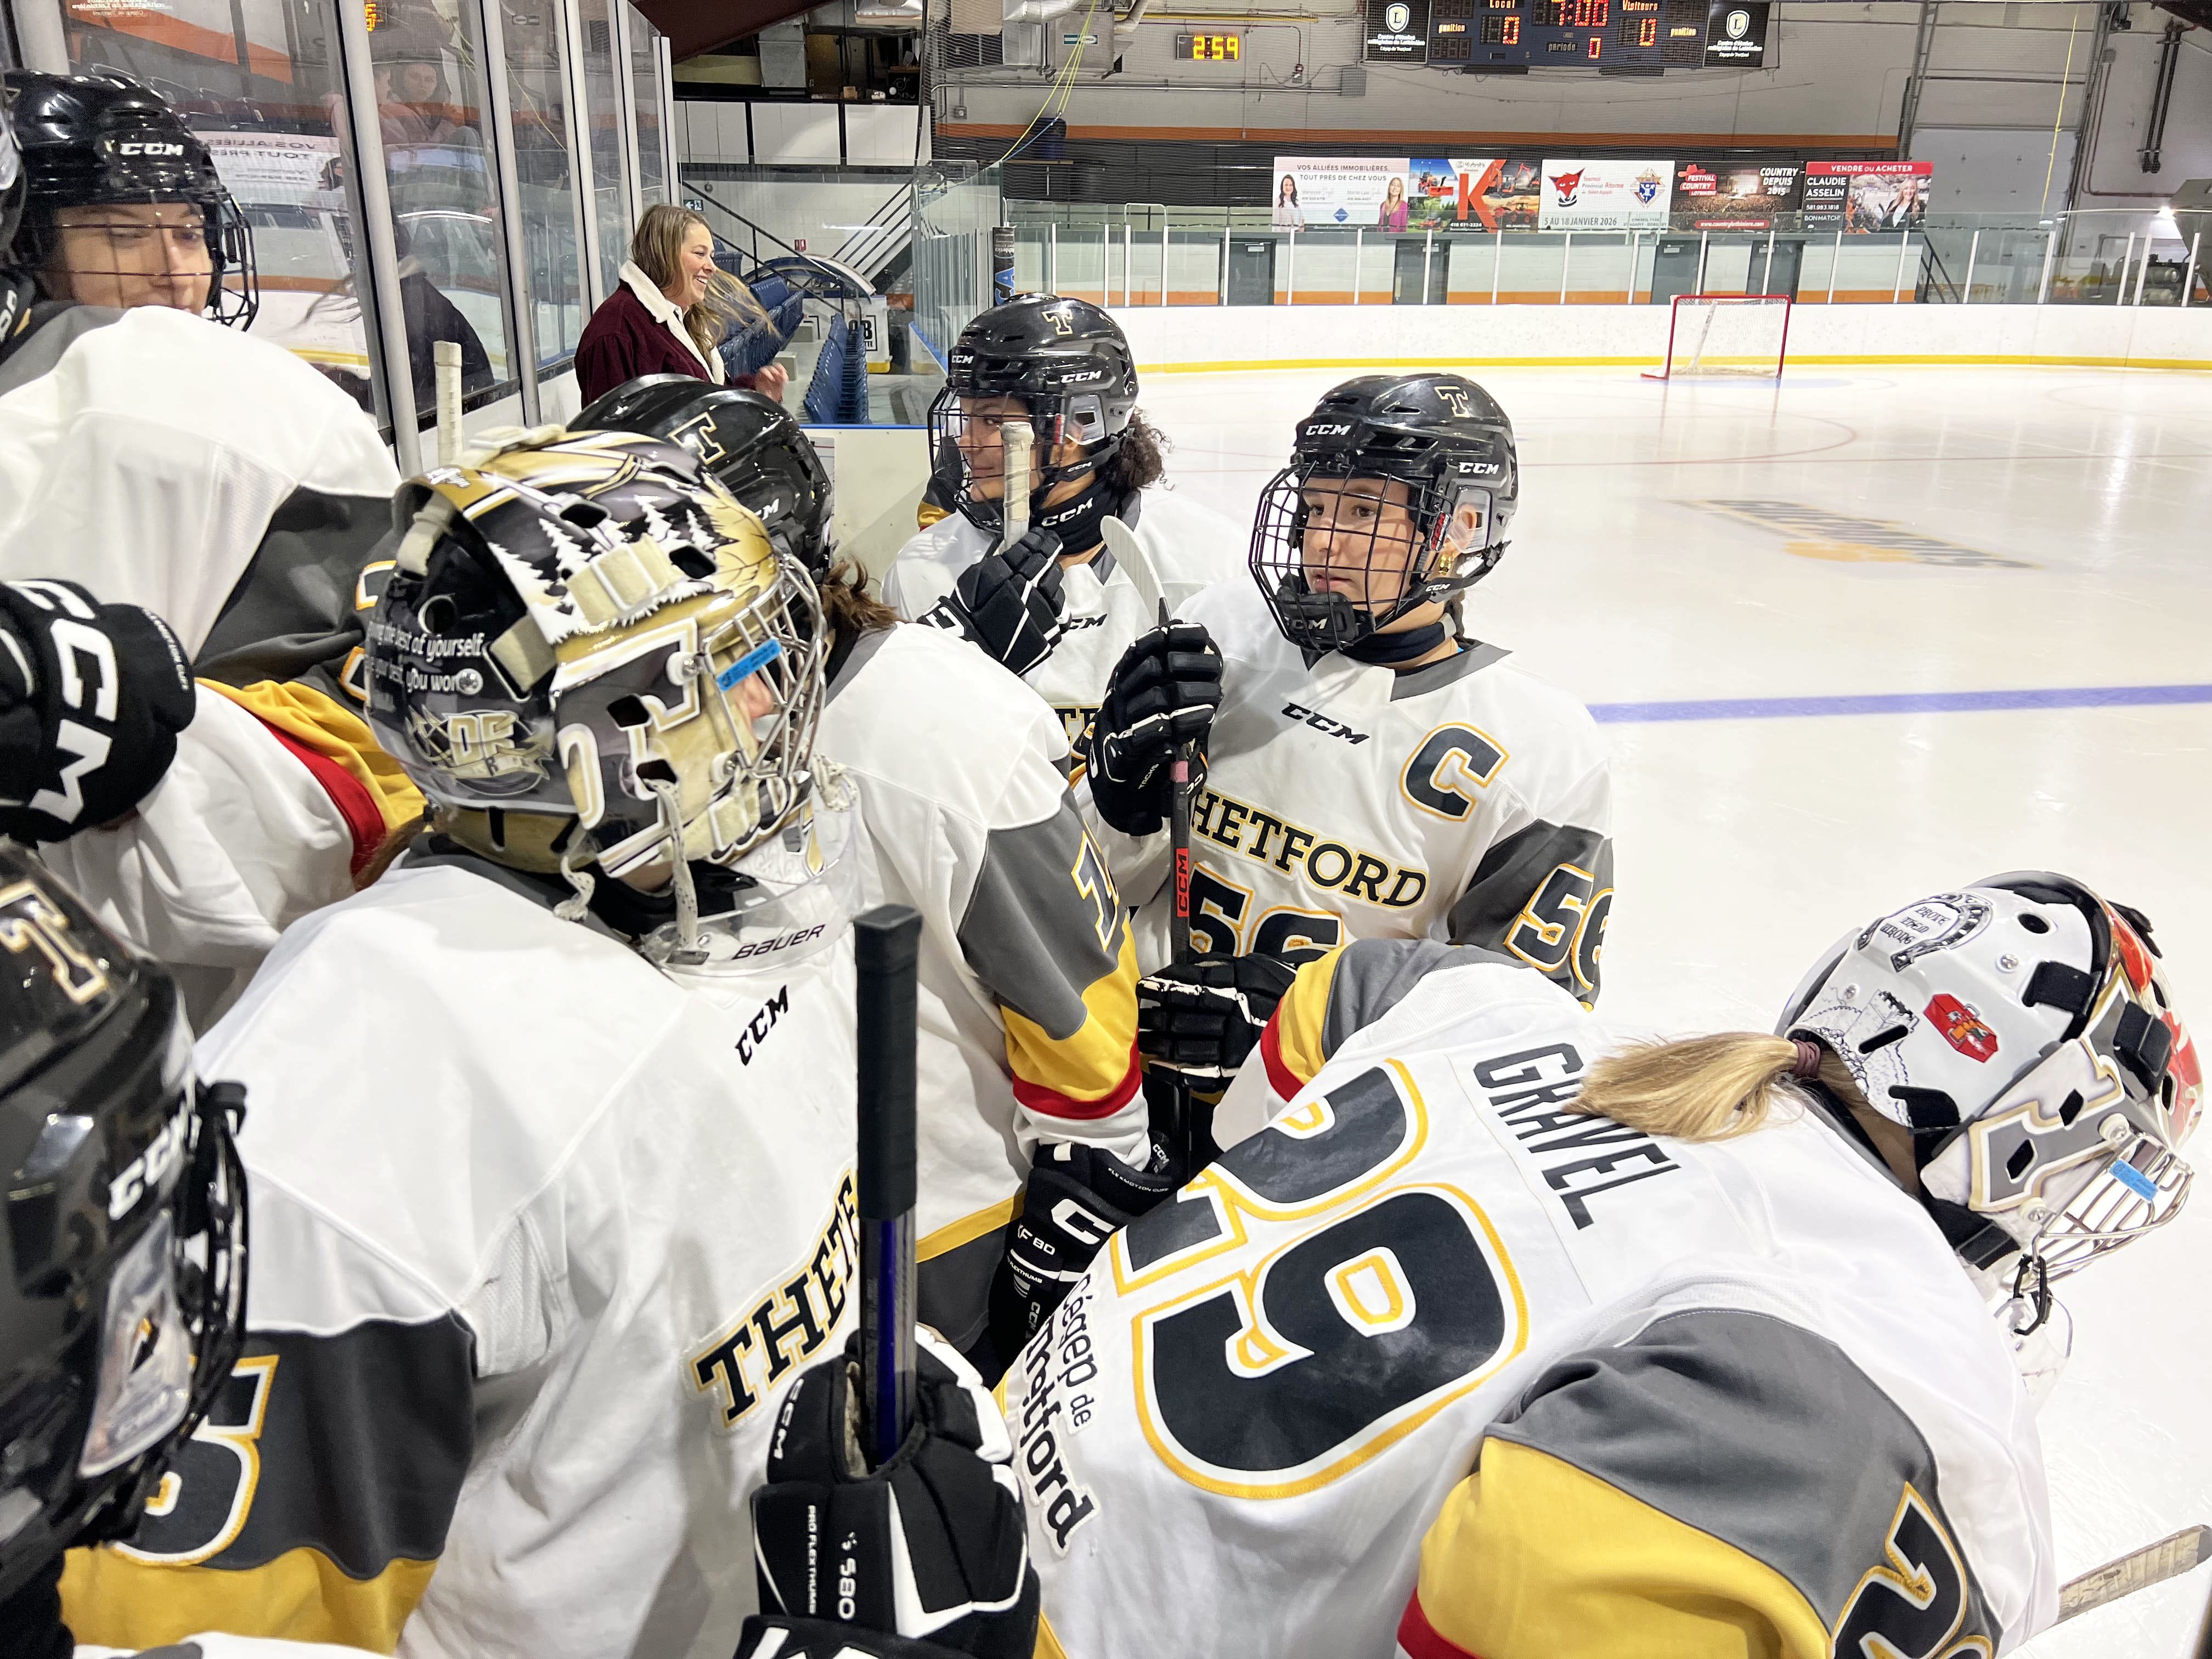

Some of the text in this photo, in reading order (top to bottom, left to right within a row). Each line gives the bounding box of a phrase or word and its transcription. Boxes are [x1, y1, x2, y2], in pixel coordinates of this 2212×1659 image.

[1489, 0, 1515, 9] Local
[1622, 0, 1658, 11] Visiteurs
[1438, 24, 1465, 33] punition
[1502, 16, 1520, 44] 0
[1639, 18, 1657, 46] 0
[1670, 27, 1697, 37] punition
[1193, 36, 1239, 60] 2:59
[1588, 37, 1602, 59] 0
[120, 143, 184, 156] CCM
[1760, 167, 1798, 176] COUNTRY
[1763, 177, 1793, 185] DEPUIS
[1807, 177, 1847, 185] CLAUDIE
[1767, 187, 1786, 196] 2015
[1805, 188, 1844, 197] ASSELIN
[1570, 217, 1599, 225] JANVIER
[1042, 309, 1073, 336] T
[951, 355, 974, 364] CCM
[1059, 370, 1102, 384] CCM
[1434, 386, 1471, 418] T
[668, 411, 727, 466] T
[1306, 424, 1352, 436] CCM
[1067, 461, 1093, 473] CCM
[1458, 461, 1500, 474] CCM
[1041, 497, 1093, 527] CCM
[1425, 583, 1451, 592] CCM
[1070, 613, 1108, 630] CM
[411, 632, 428, 655] of
[426, 631, 486, 663] yourself
[406, 668, 428, 693] you
[1282, 702, 1370, 745] CCM
[1400, 721, 1511, 822] C
[1190, 785, 1429, 910] HETFORD
[1179, 853, 1188, 913] CCM
[731, 924, 826, 961] BAUER
[735, 984, 789, 1066] CCM
[1472, 1042, 1682, 1231] GRAVEL
[1153, 1143, 1170, 1164] CCM
[1032, 1237, 1056, 1256] 80
[1069, 1393, 1094, 1428] de
[808, 1505, 817, 1532] PRO
